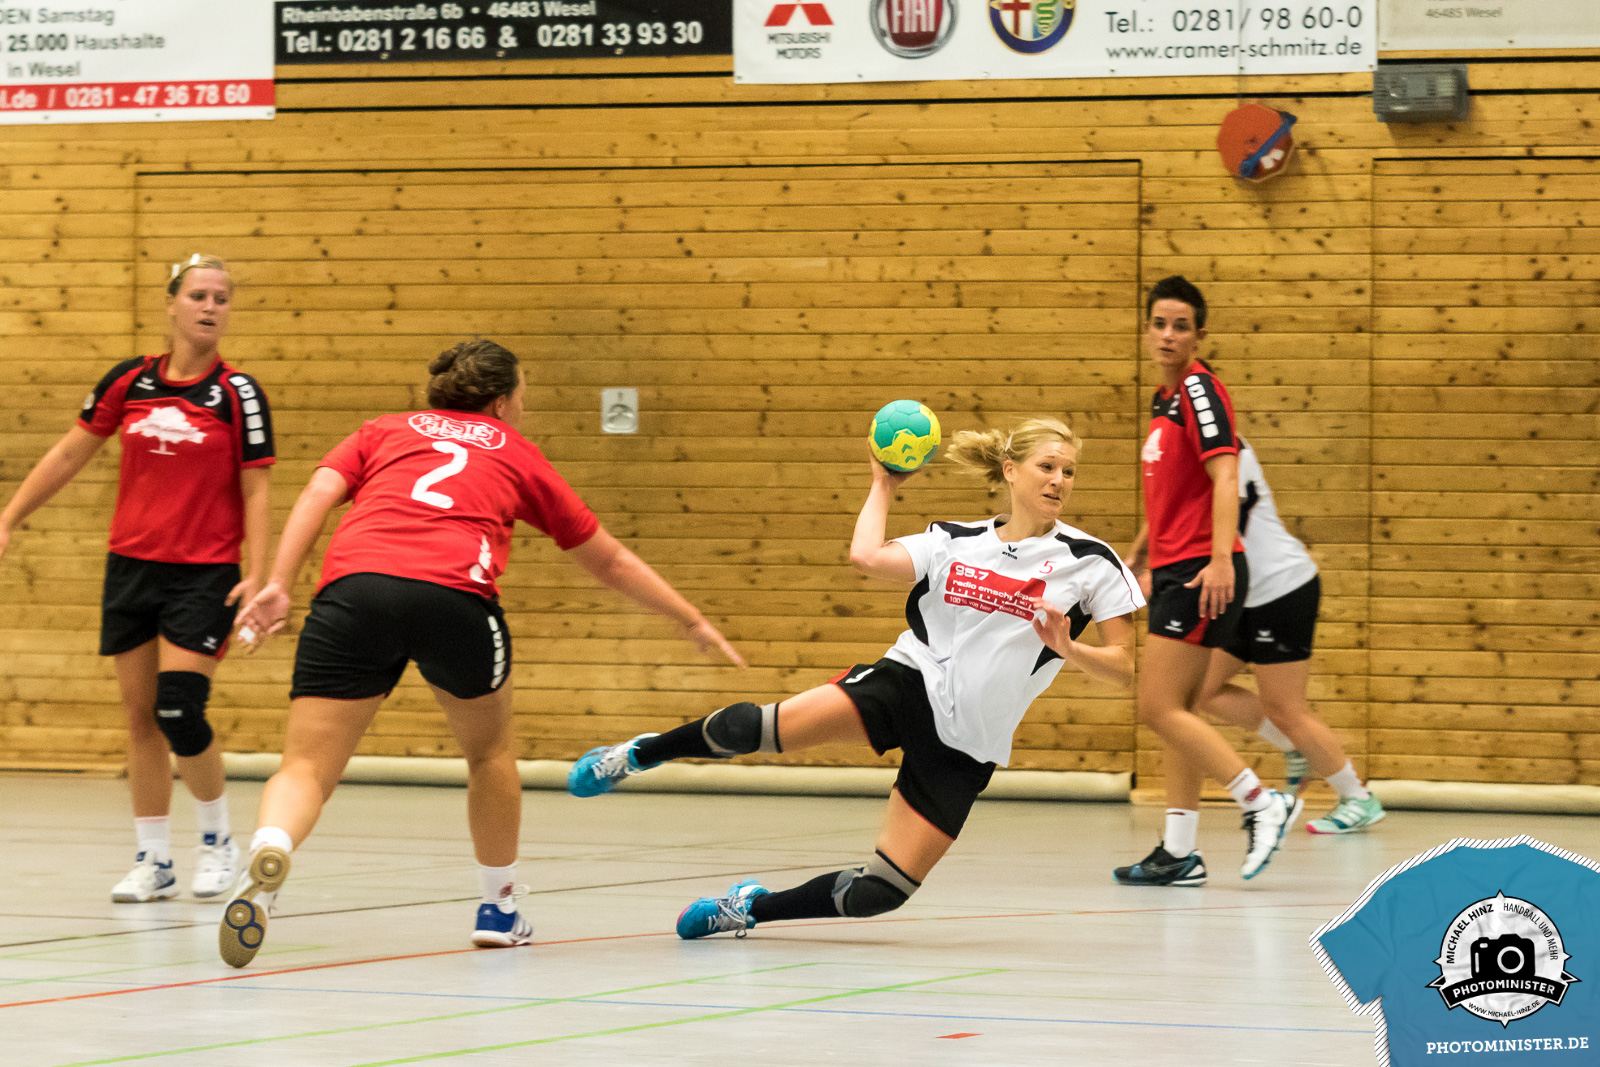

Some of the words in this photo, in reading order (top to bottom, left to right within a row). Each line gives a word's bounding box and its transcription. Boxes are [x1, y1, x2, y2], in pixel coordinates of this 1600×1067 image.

[38, 8, 114, 26] Samstag
[440, 3, 464, 19] 6b
[486, 1, 540, 18] 46483
[543, 0, 597, 17] Wesel
[1104, 9, 1153, 33] Tel.:
[1260, 8, 1291, 30] 98
[1302, 6, 1362, 29] 60-0
[7, 33, 67, 52] 25.000
[75, 34, 165, 50] Haushalte
[281, 30, 333, 53] Tel.:
[338, 28, 392, 51] 0281
[400, 28, 416, 50] 2
[422, 27, 452, 50] 16
[456, 26, 486, 49] 66
[498, 25, 518, 48] &
[537, 23, 593, 47] 0281
[601, 23, 632, 46] 33
[636, 22, 667, 45] 93
[672, 21, 703, 44] 30
[767, 32, 831, 44] MITSUBISHI
[776, 47, 822, 60] MOTORS
[1106, 35, 1362, 59] www.cramer-schmitz.de
[7, 63, 22, 77] in
[28, 62, 81, 77] Wesel
[65, 87, 114, 107] 0281
[133, 86, 159, 106] 47
[164, 85, 190, 105] 36
[194, 84, 219, 104] 78
[224, 83, 250, 104] 60
[204, 385, 222, 407] 3
[411, 441, 468, 509] 2
[955, 564, 989, 581] 98.7
[1039, 560, 1057, 574] 5
[952, 579, 977, 590] radio
